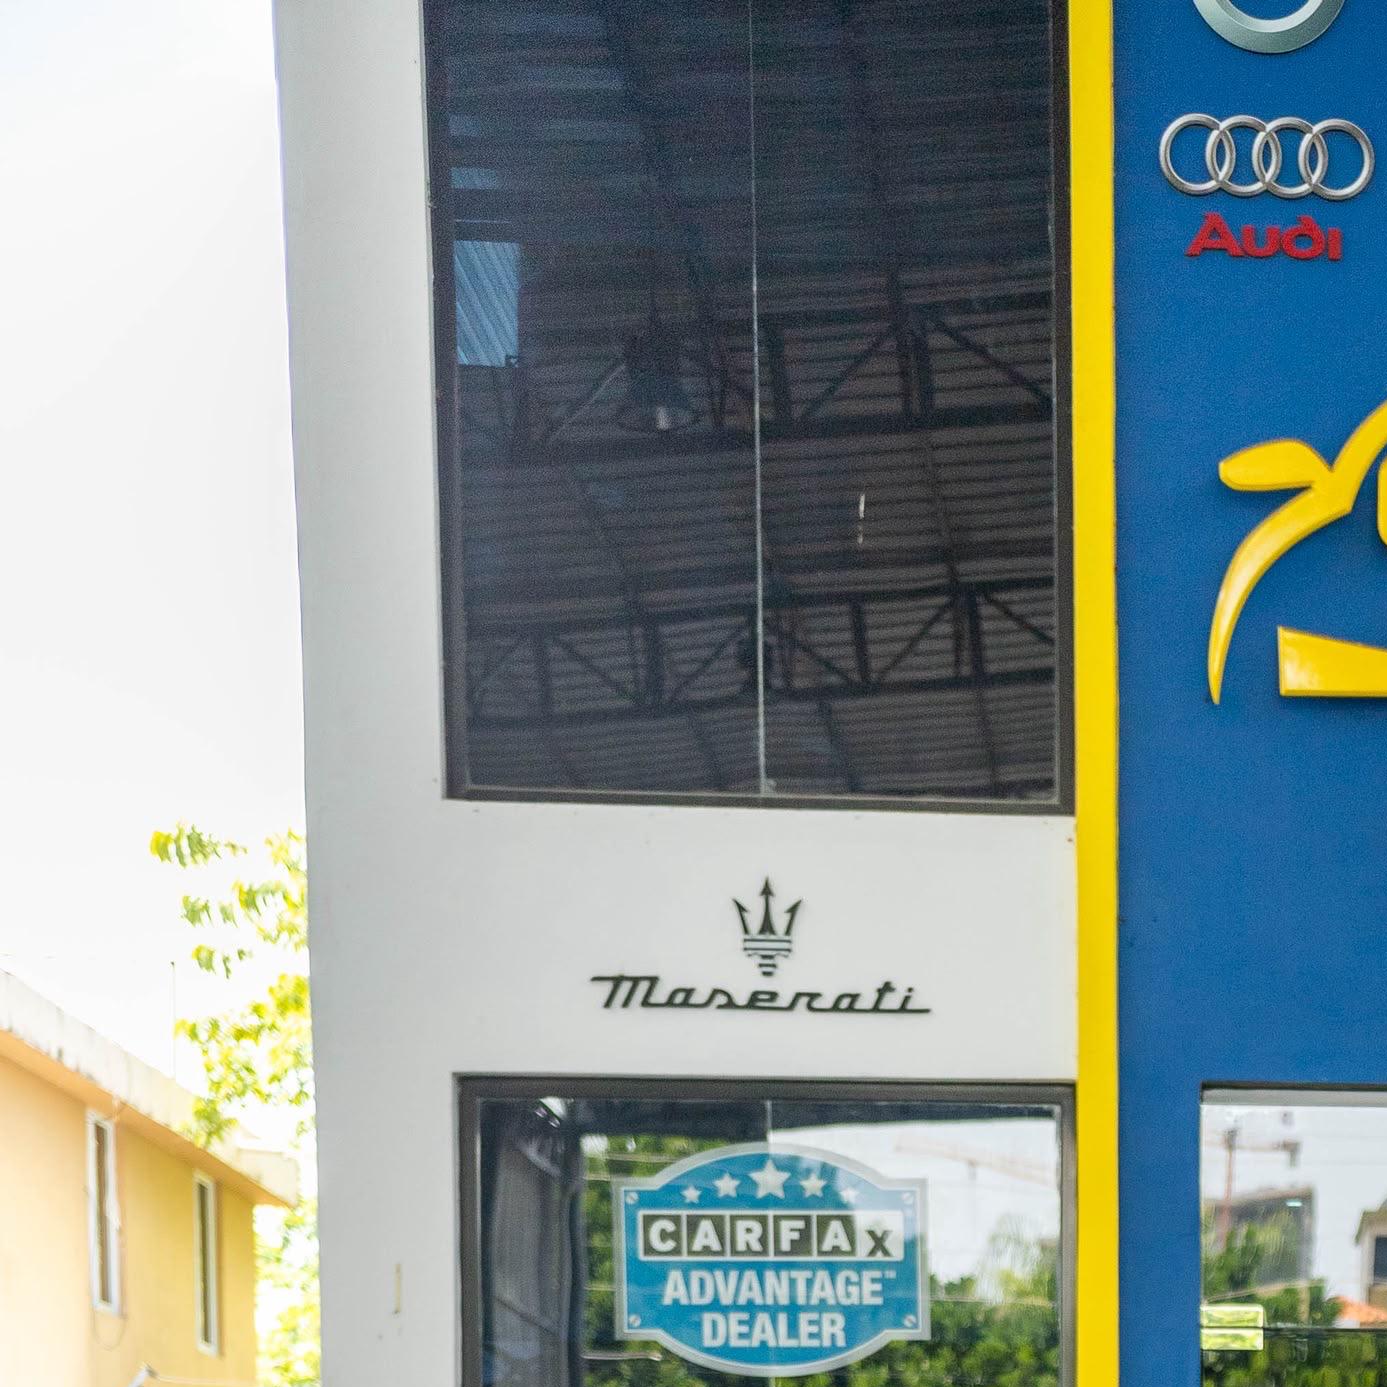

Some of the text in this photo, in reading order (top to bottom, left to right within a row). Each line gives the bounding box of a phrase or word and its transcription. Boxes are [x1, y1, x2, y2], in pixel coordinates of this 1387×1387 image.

[1186, 210, 1343, 262] Audi
[590, 975, 932, 1014] Maserati
[643, 1213, 896, 1258] CARFAX
[703, 1312, 848, 1348] DEALER
